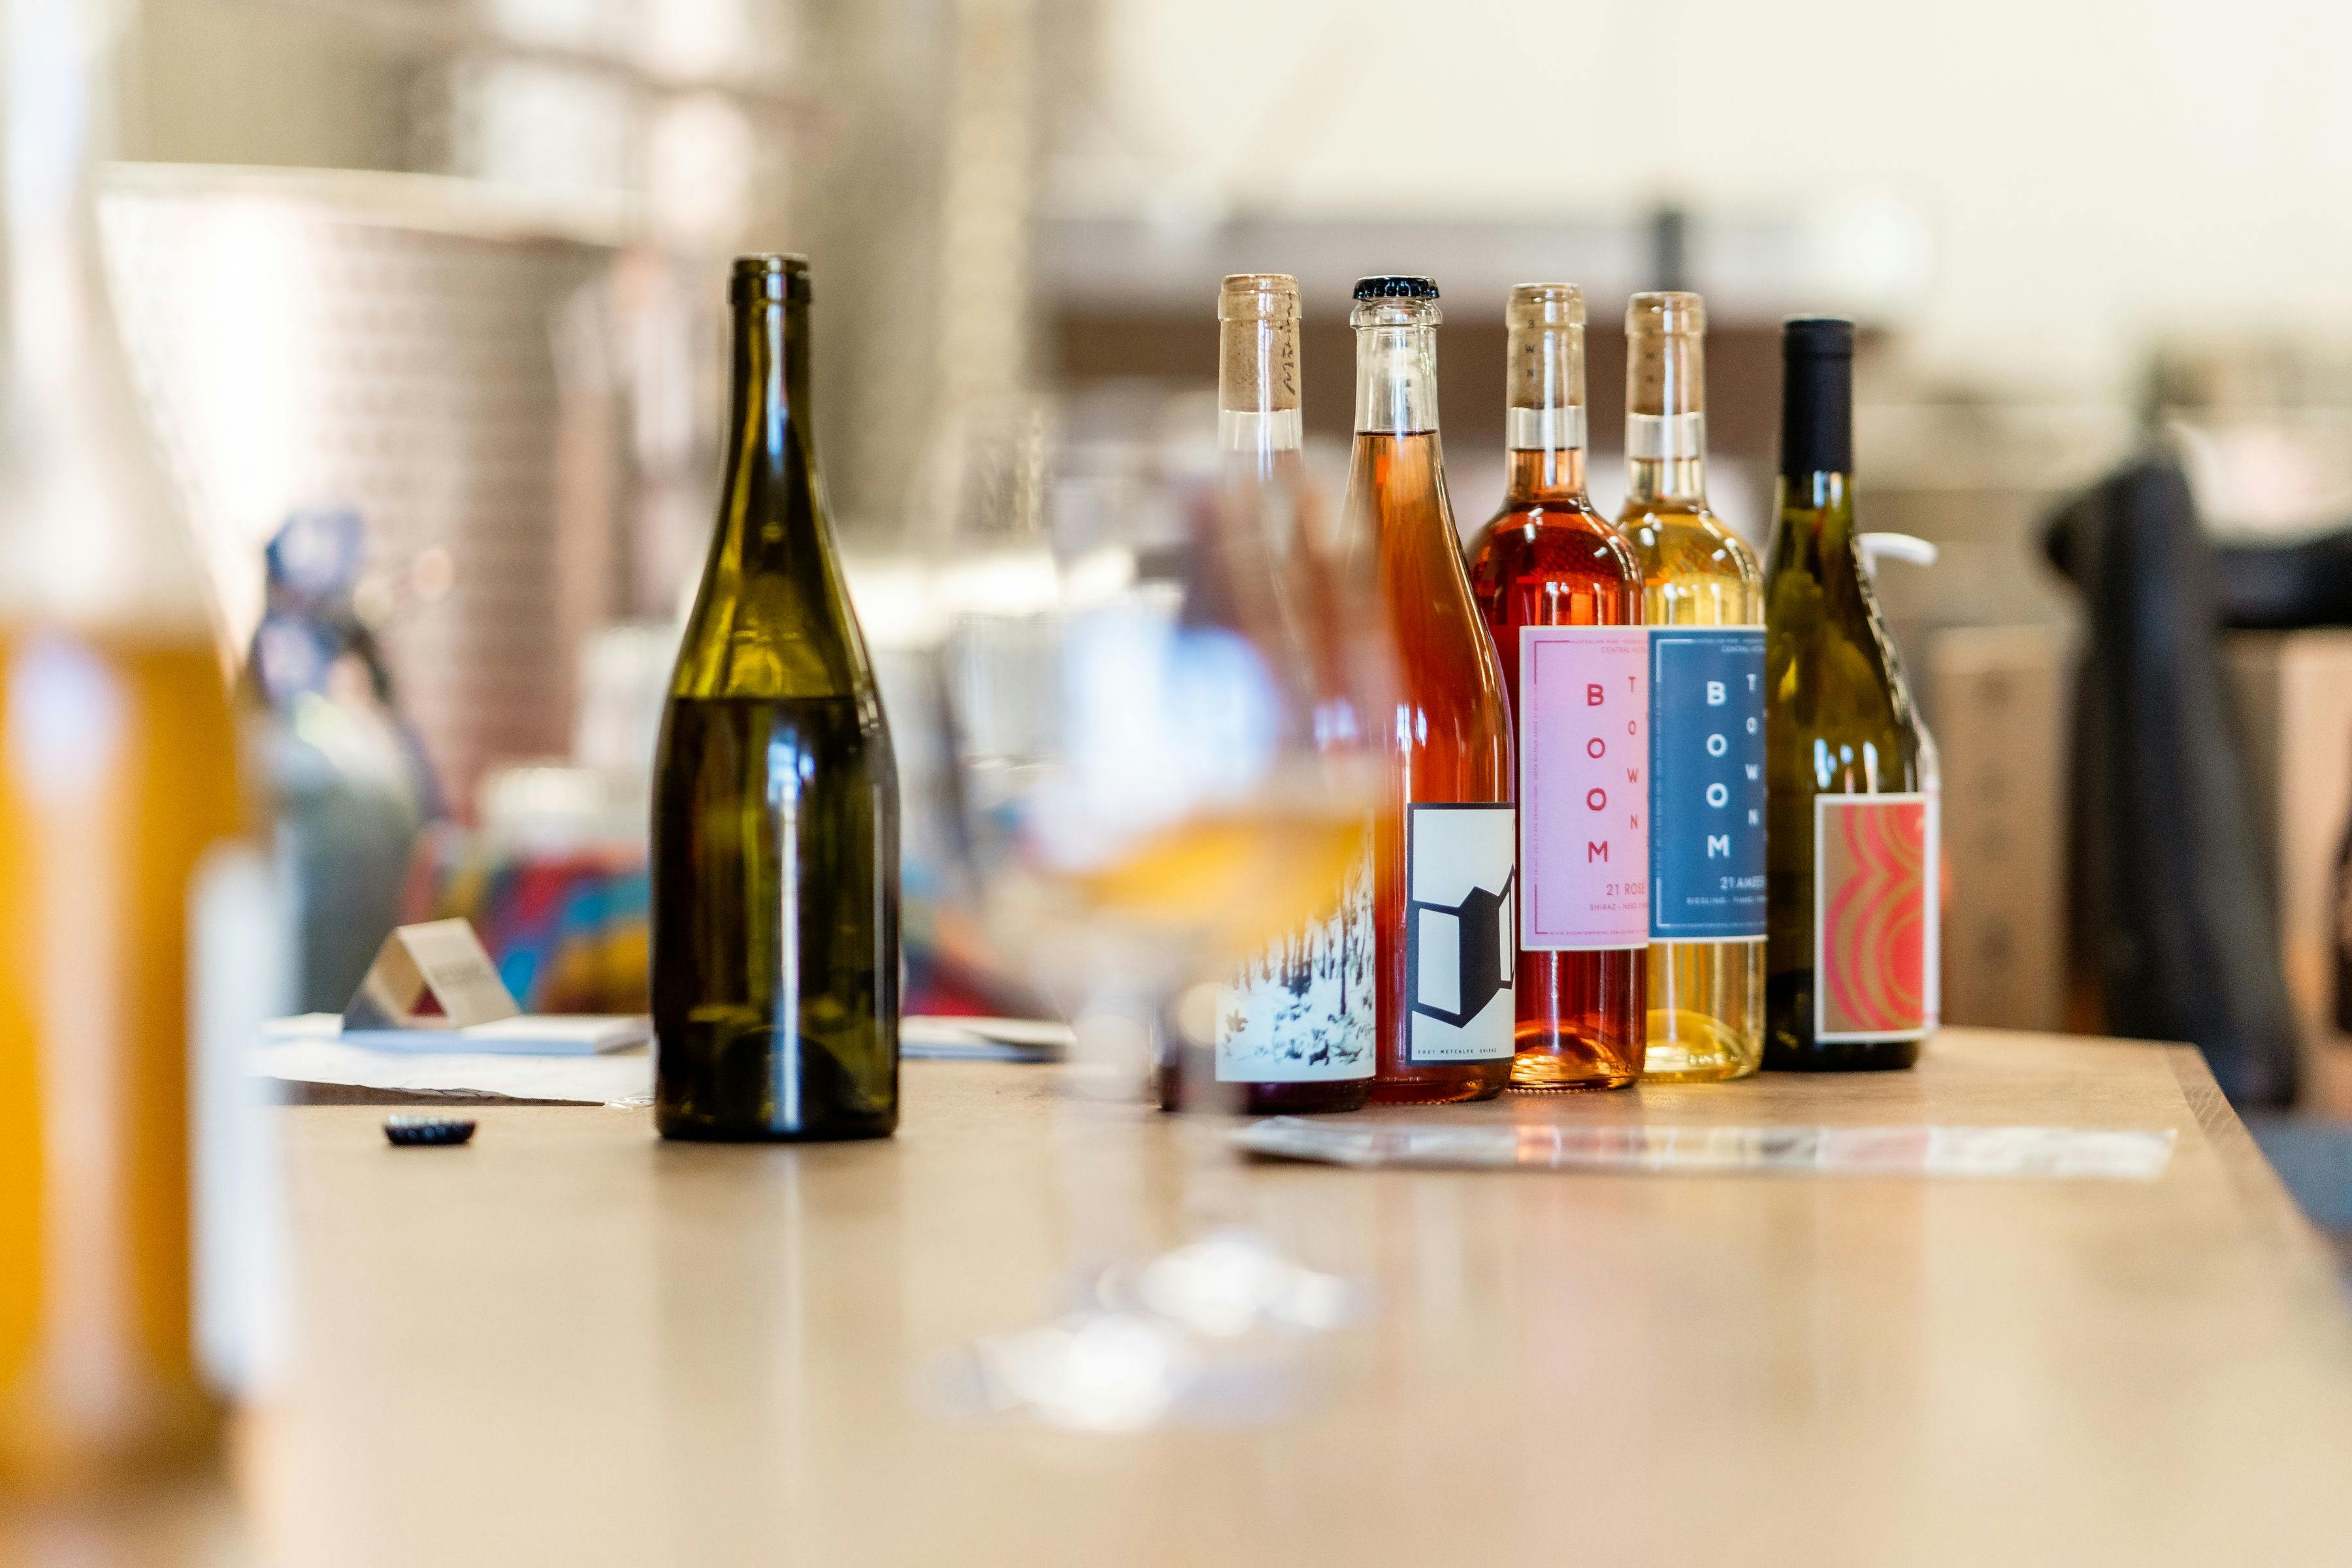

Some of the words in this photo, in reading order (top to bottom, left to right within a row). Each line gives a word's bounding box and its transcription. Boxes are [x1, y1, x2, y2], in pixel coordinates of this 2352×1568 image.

[1586, 683, 1608, 863] BOOM
[1627, 676, 1639, 828] TOWN
[1706, 680, 1730, 858] BOOM
[1745, 673, 1759, 826] TOWN
[1606, 883, 1619, 895] 21
[1720, 876, 1734, 889] 21
